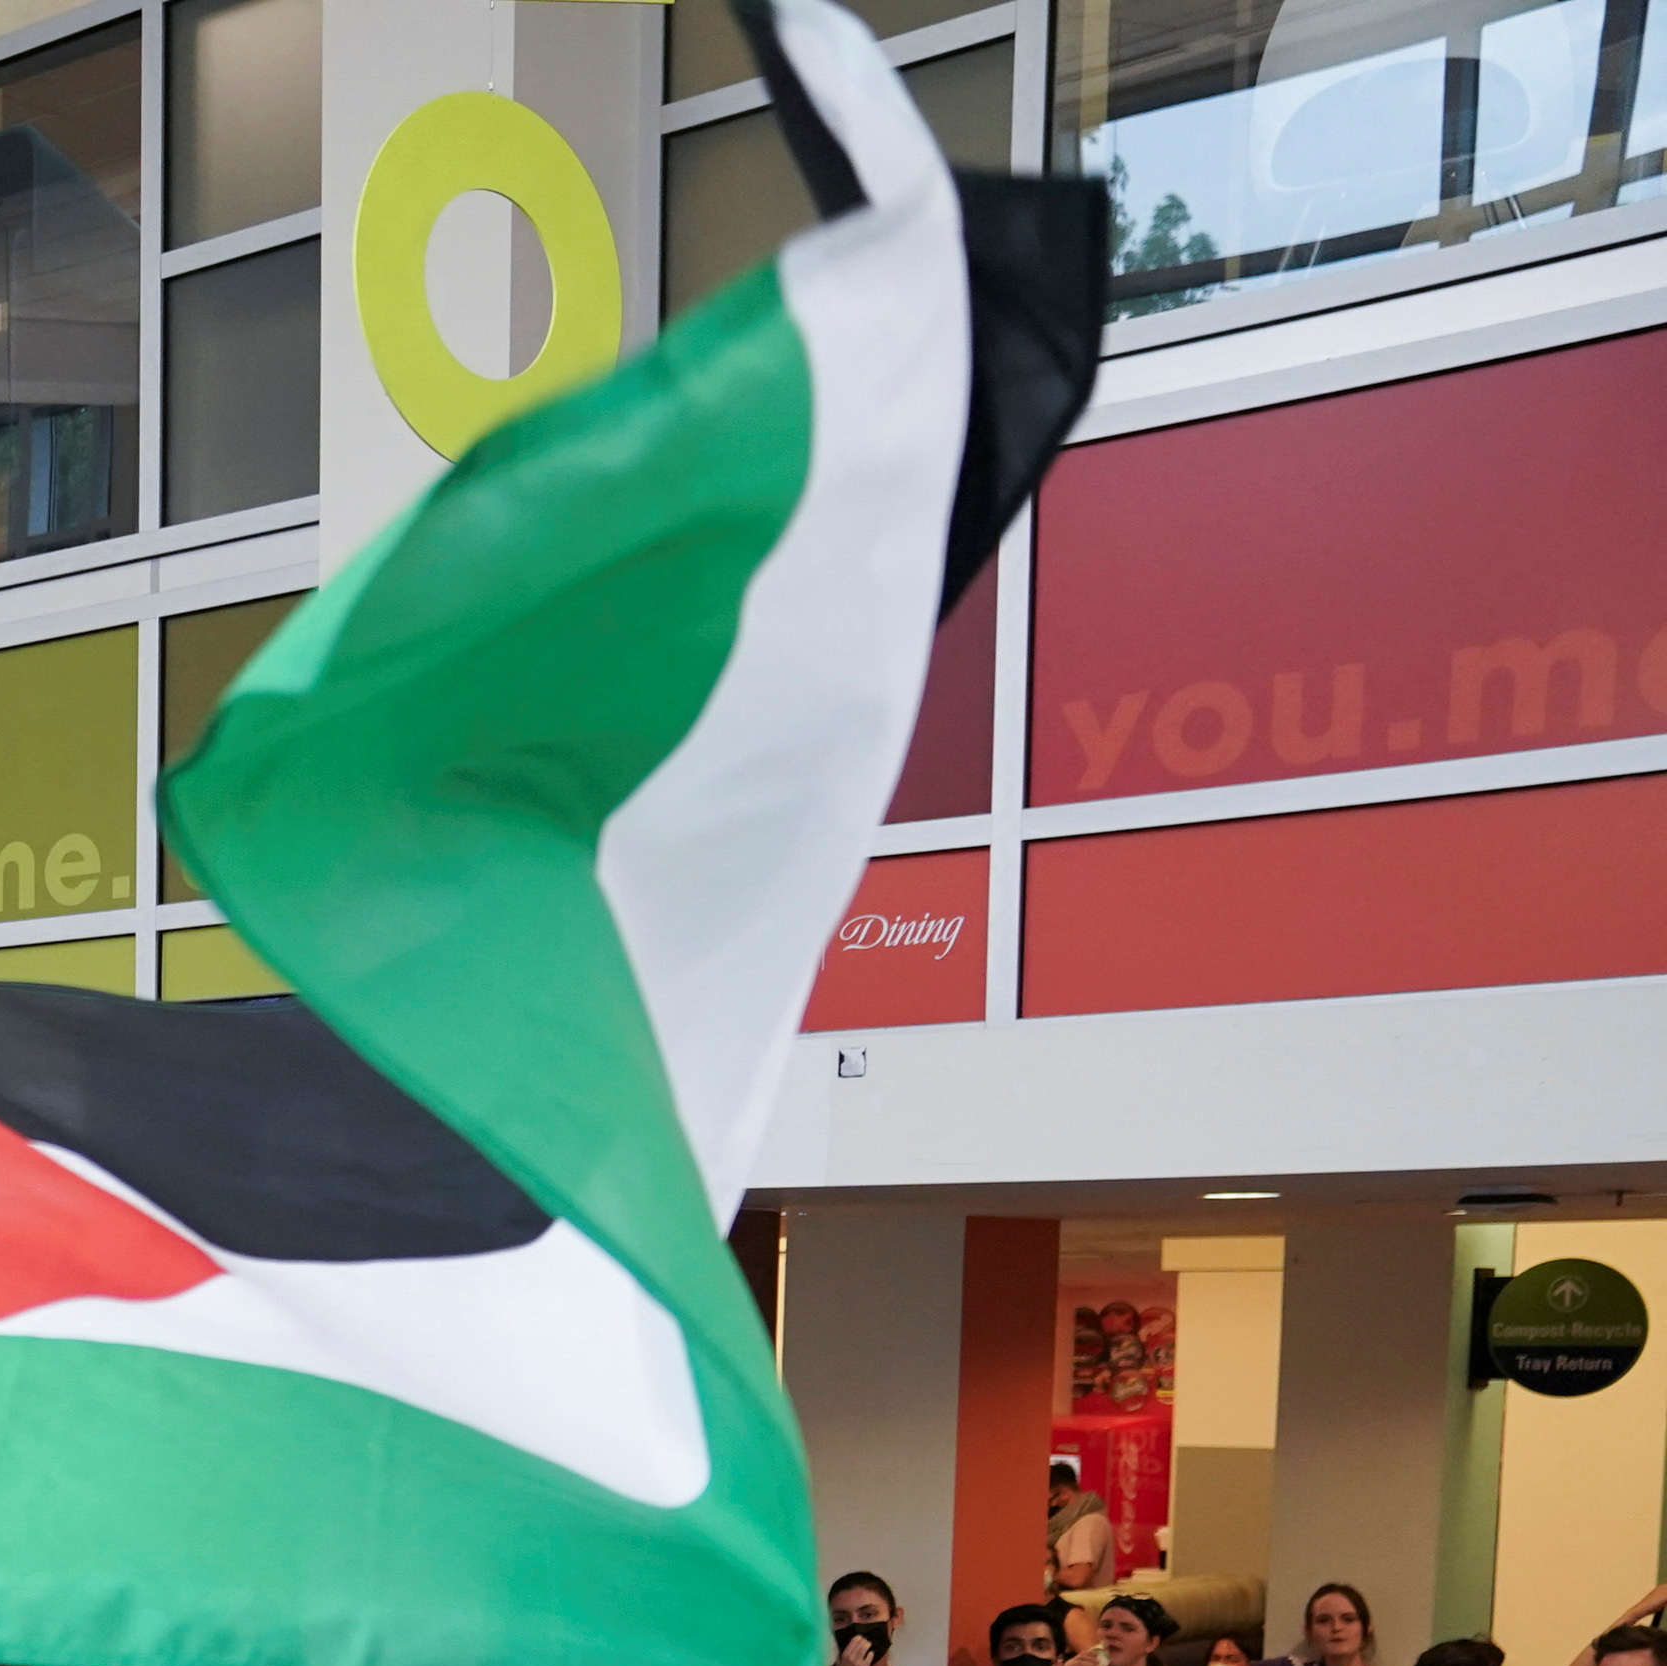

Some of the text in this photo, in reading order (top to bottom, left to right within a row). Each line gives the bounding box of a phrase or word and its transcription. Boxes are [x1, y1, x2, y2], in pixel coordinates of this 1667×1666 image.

[839, 911, 965, 961] Dining
[1492, 1321, 1643, 1341] Compost Recycle
[1517, 1355, 1613, 1374] Tray Return
